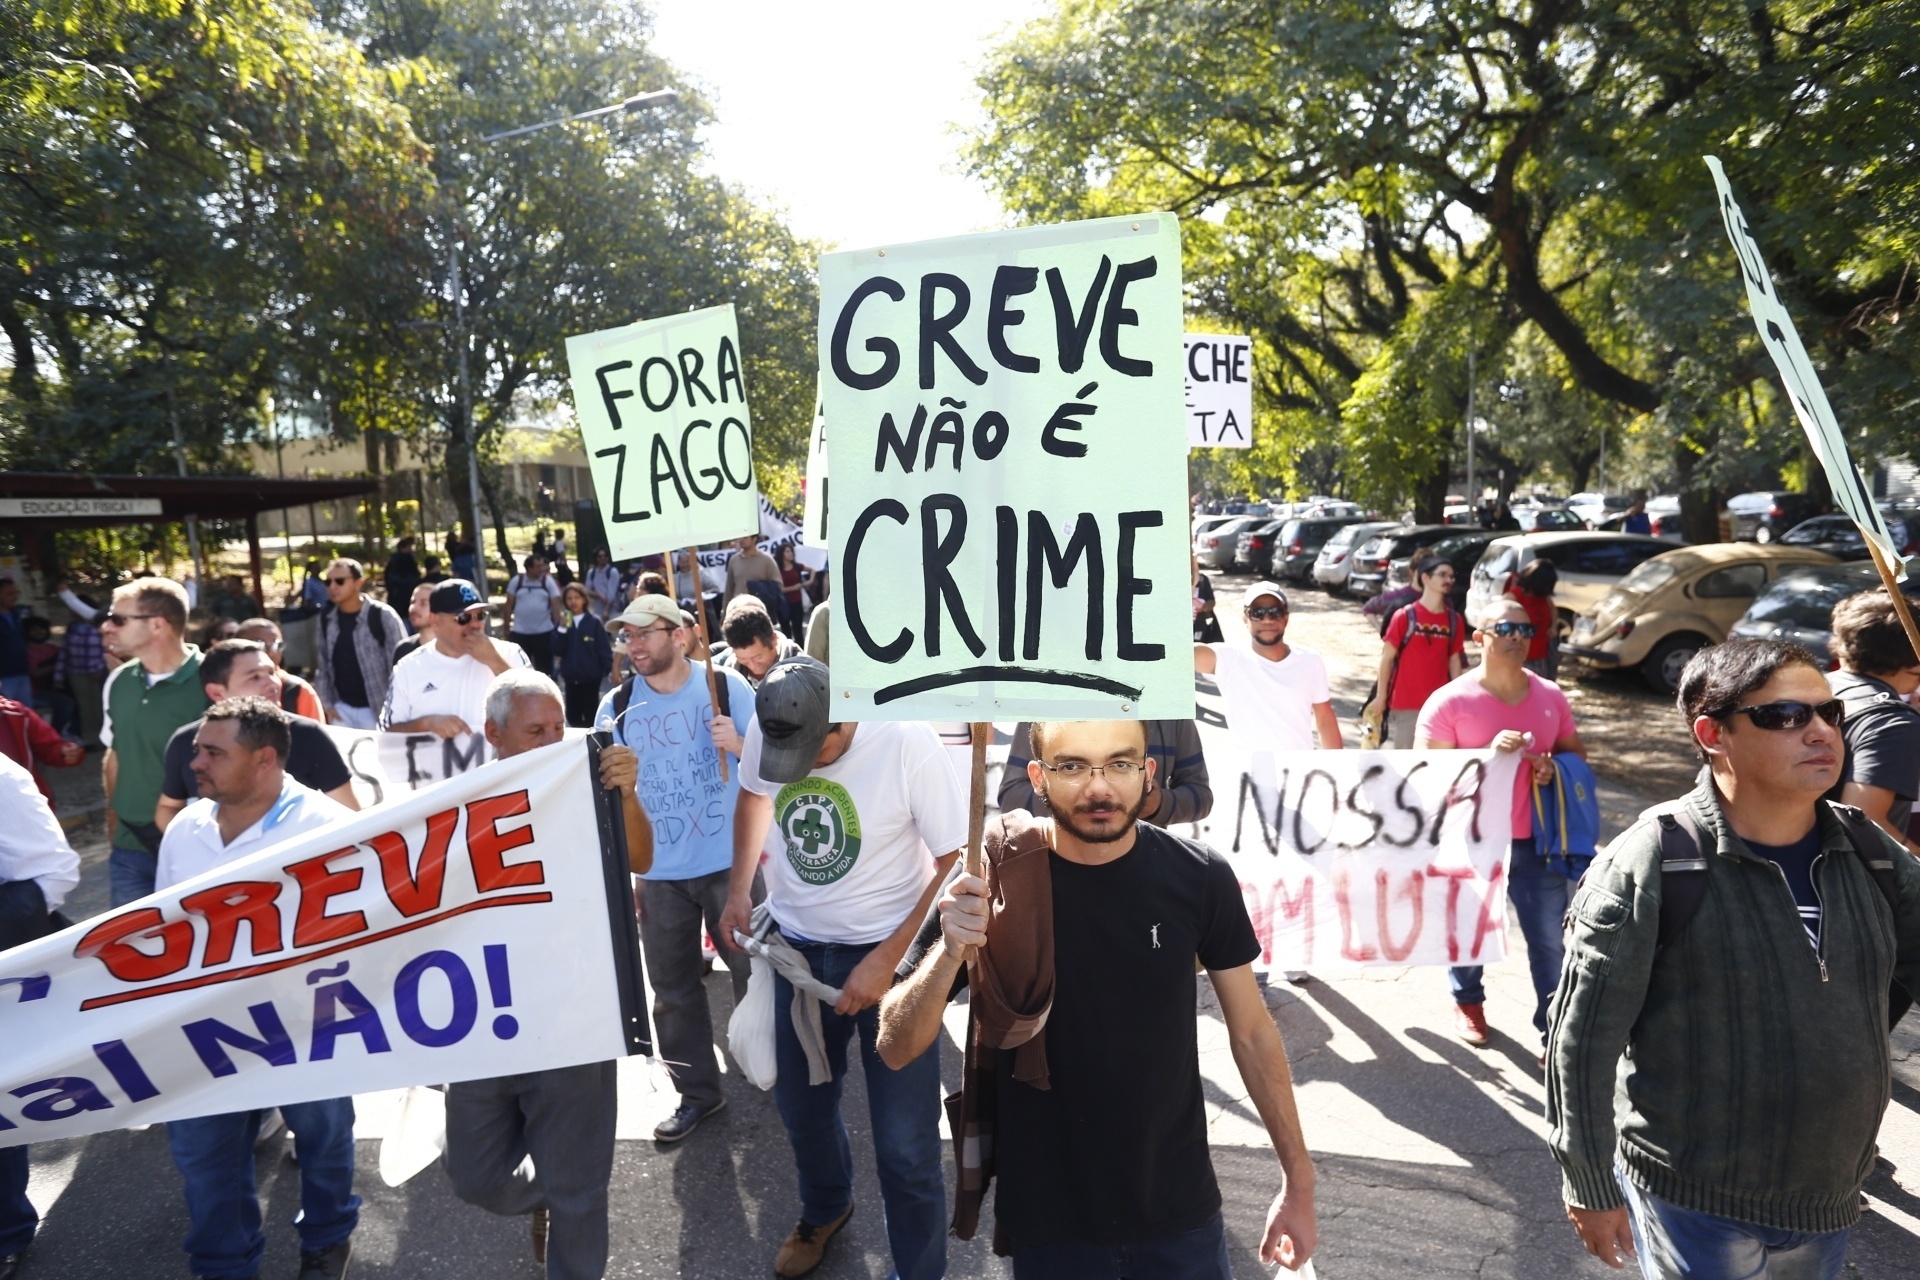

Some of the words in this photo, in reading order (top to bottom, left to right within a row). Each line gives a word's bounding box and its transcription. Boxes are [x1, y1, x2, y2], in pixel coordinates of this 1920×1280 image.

[831, 254, 1157, 390] GREVE
[1184, 342, 1249, 384] CHE
[595, 336, 745, 430] FORA
[875, 397, 1009, 473] NÃO
[1041, 382, 1099, 458] É
[595, 417, 752, 523] ZAGO
[842, 493, 1166, 664] CRIME
[627, 703, 713, 753] GREVE
[796, 796, 834, 813] CIPA
[824, 785, 857, 834] ACIDENTES
[1231, 758, 1487, 857] NOSSA
[74, 789, 546, 982] GREVE
[833, 855, 853, 874] VIDA
[1337, 860, 1509, 963] LUTA
[0, 1039, 161, 1132] al
[182, 944, 519, 1079] NÃO!
